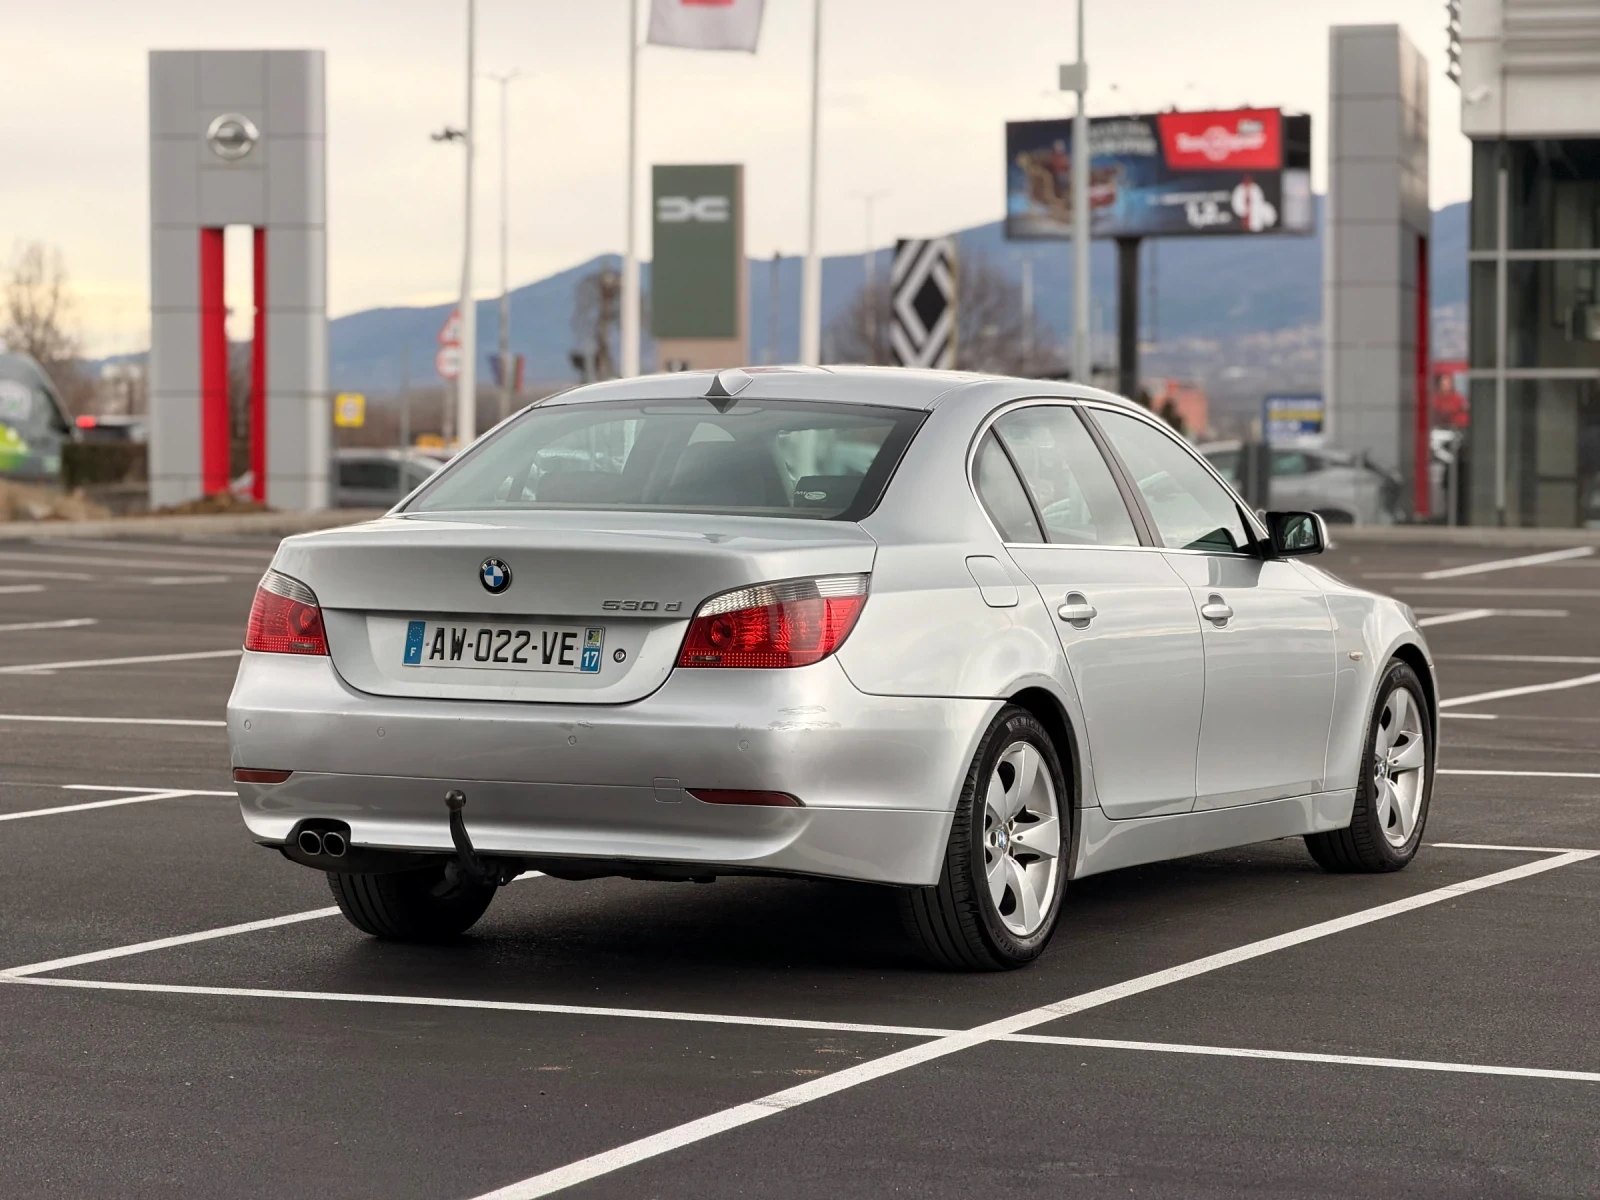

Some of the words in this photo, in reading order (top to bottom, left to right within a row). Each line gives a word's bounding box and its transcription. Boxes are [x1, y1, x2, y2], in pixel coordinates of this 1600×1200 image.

[482, 560, 507, 571] BMW
[602, 600, 659, 610] 530
[664, 601, 682, 611] d
[410, 647, 416, 657] F
[429, 627, 578, 666] AW-022-VE
[583, 651, 599, 667] 17
